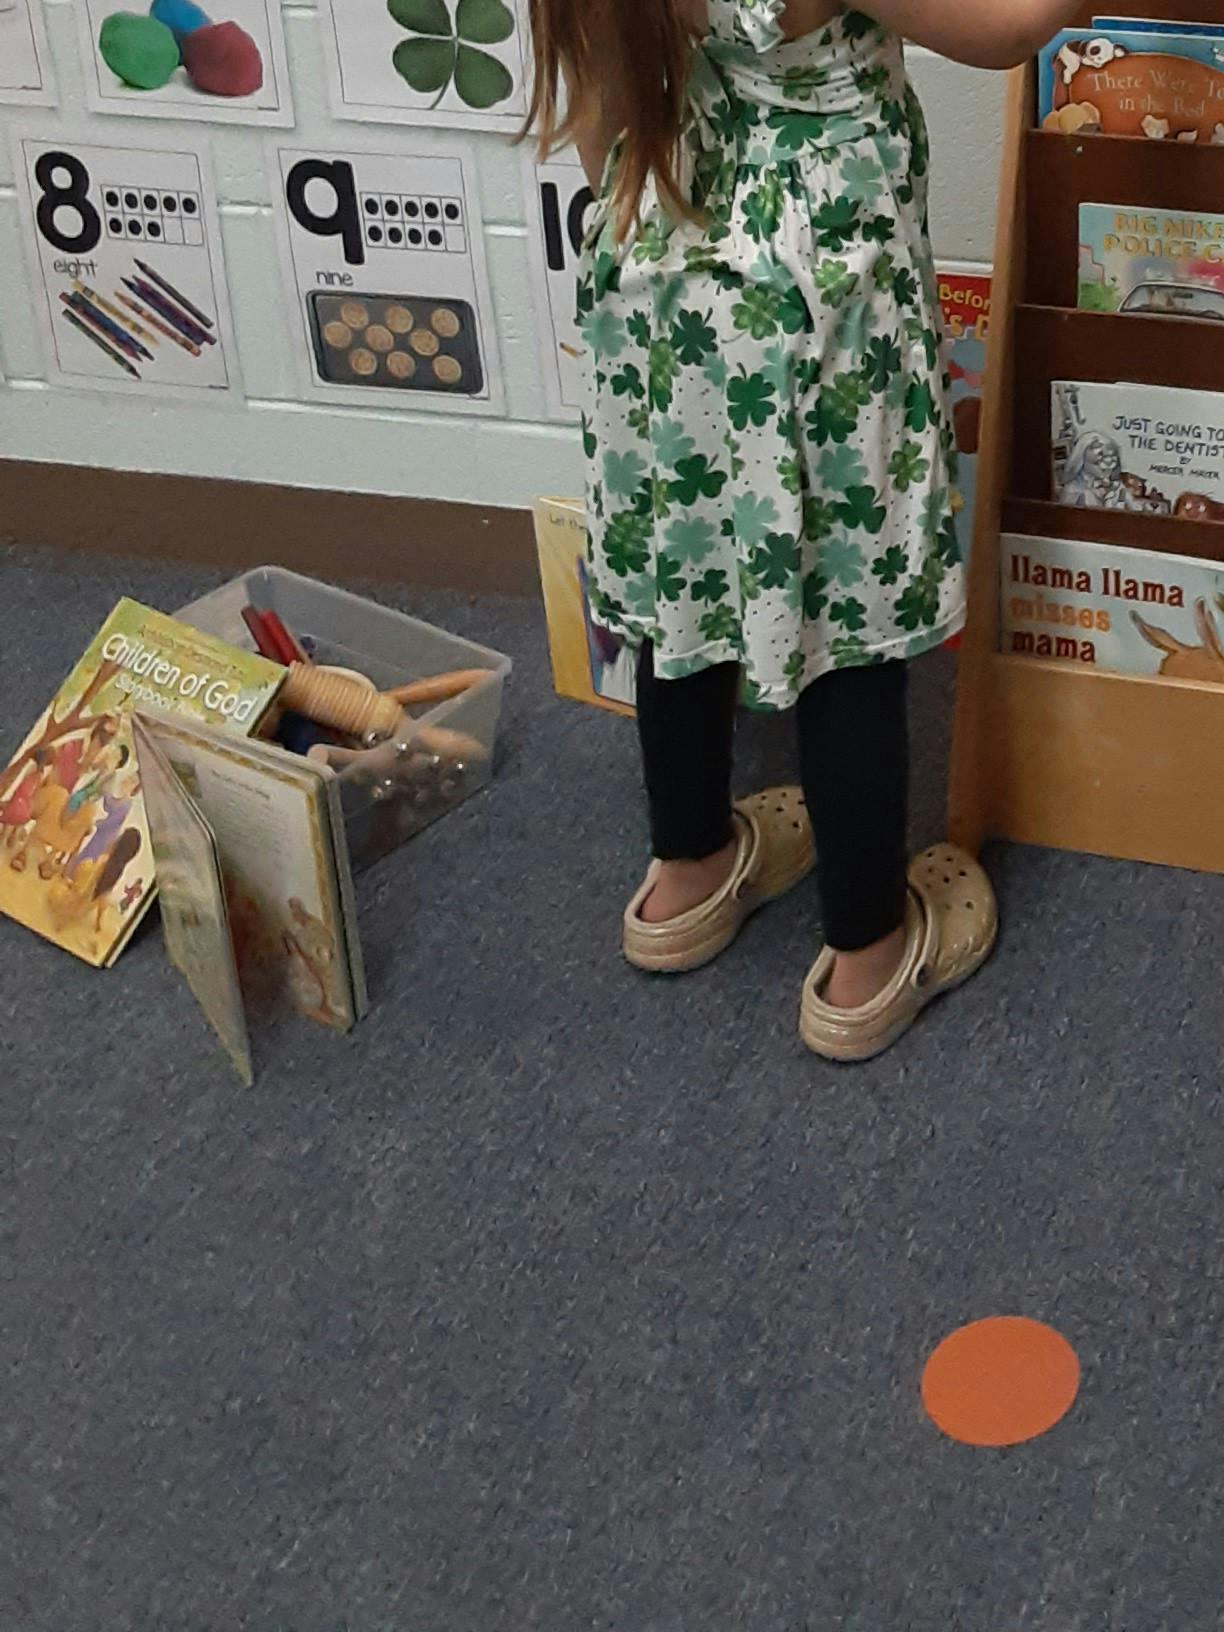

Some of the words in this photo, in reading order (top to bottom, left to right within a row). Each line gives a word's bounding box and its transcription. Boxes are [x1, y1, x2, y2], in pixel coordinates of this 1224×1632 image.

[1091, 70, 1144, 92] There
[1119, 95, 1135, 111] in
[1141, 94, 1166, 114] the
[1173, 97, 1205, 118] Bed
[35, 150, 101, 253] 8
[285, 159, 365, 265] 9
[1114, 213, 1158, 235] BIG
[1103, 233, 1197, 259] POLICE
[53, 258, 99, 278] eight
[316, 269, 354, 287] nine
[1112, 415, 1152, 432] JUST
[1155, 421, 1201, 439] GOING
[1128, 434, 1157, 450] THE
[1010, 554, 1092, 594] llama
[1100, 567, 1184, 608] llama
[1010, 595, 1112, 633] misses
[1011, 628, 1097, 664] mama
[101, 632, 182, 690] Children
[178, 673, 211, 699] of
[204, 679, 257, 722] God
